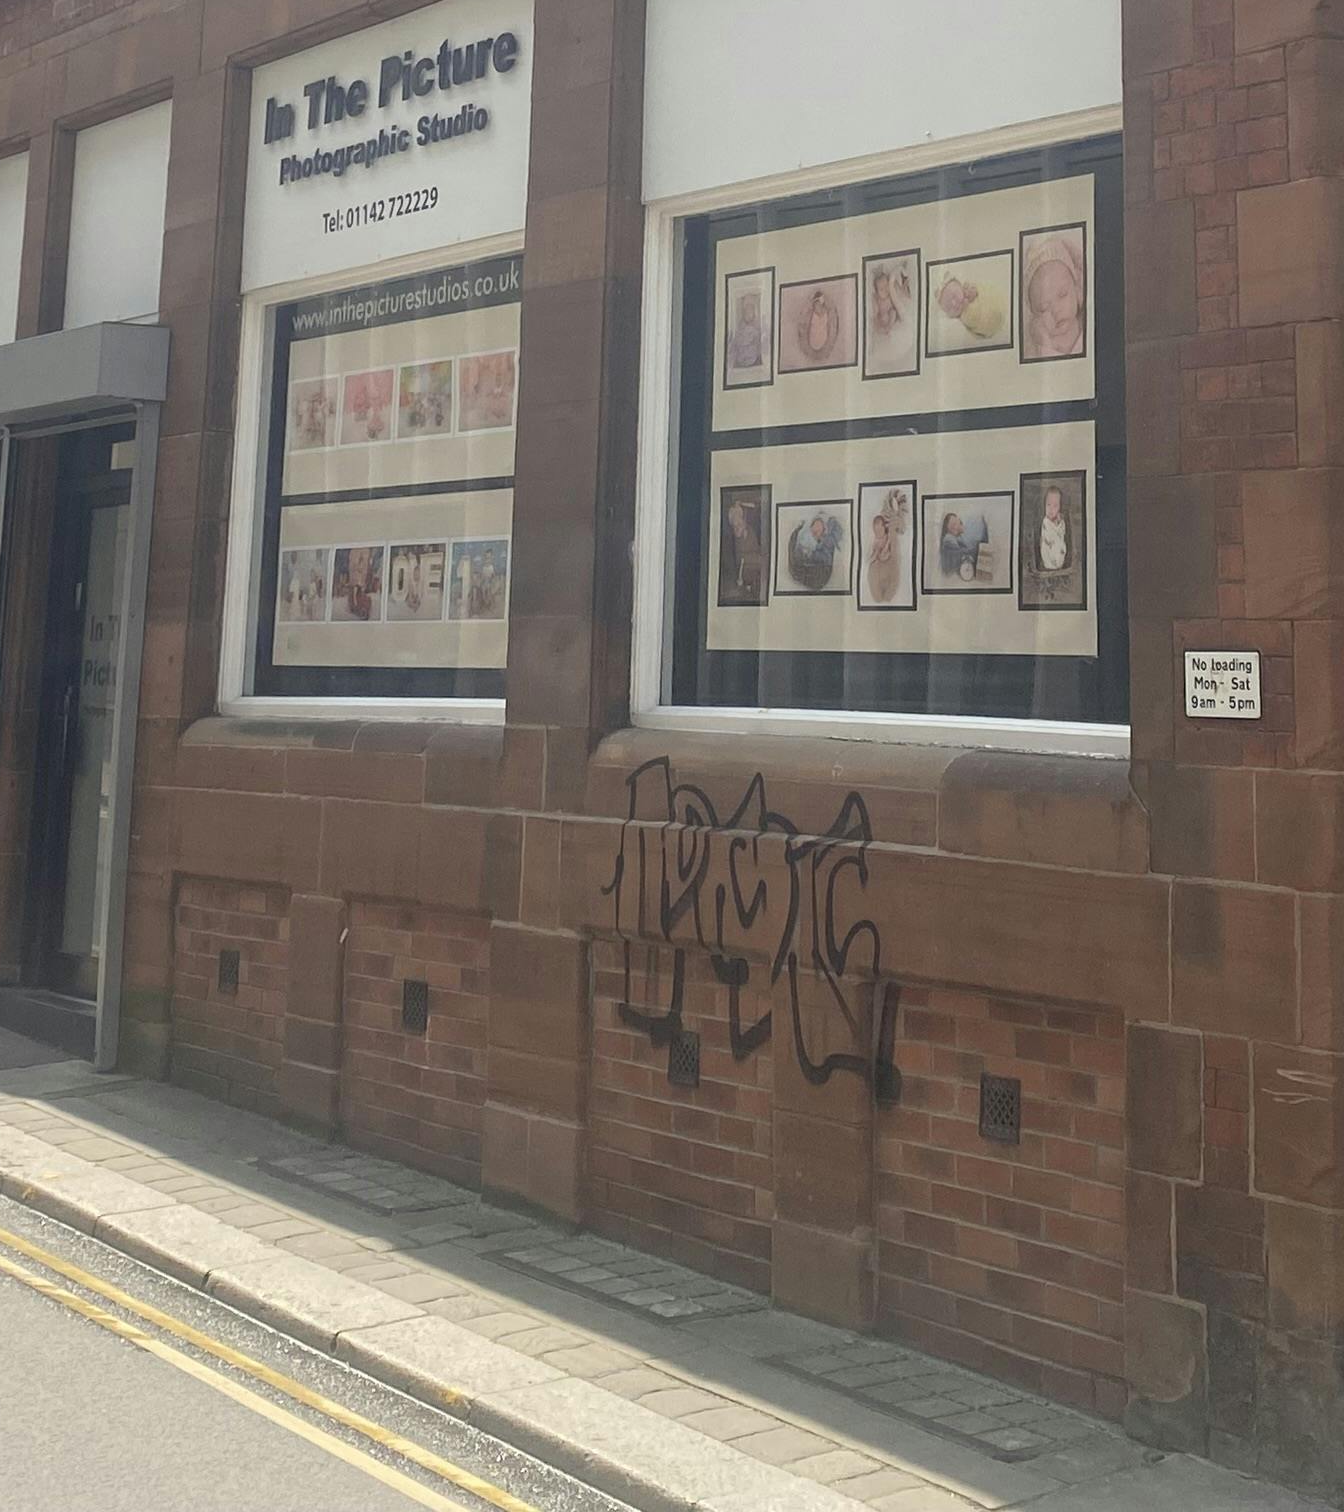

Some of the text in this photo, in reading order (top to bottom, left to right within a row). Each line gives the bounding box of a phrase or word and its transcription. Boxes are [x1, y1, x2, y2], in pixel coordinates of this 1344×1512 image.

[264, 31, 518, 145] In The Picture
[279, 103, 489, 186] Photographic Studio
[323, 186, 439, 234] Tel: 01142 722229
[292, 267, 519, 332] www.inthepicturestudios.co.uk
[1192, 658, 1253, 674] No loading
[1194, 676, 1217, 690] Mon
[1231, 677, 1251, 691] Sat
[1191, 695, 1216, 709] 9am
[1229, 696, 1256, 711] 5pm
